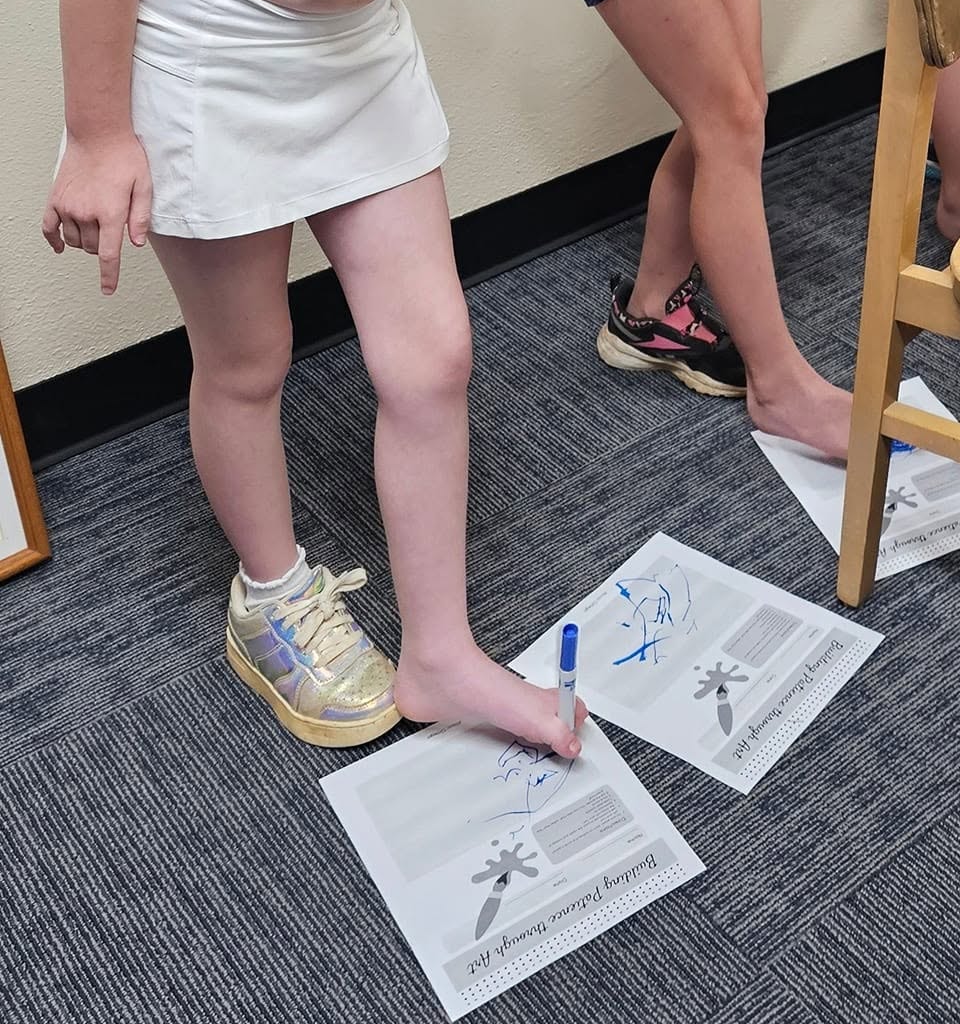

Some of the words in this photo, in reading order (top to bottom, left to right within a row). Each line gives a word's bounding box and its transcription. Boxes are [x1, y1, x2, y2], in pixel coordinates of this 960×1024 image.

[889, 535, 927, 553] through
[805, 639, 844, 673] Building
[780, 672, 814, 707] Patience
[748, 707, 782, 741] through
[732, 739, 751, 760] Art
[603, 853, 658, 890] Building
[548, 886, 603, 924] Patience
[493, 922, 548, 957] through
[466, 951, 491, 976] Art
